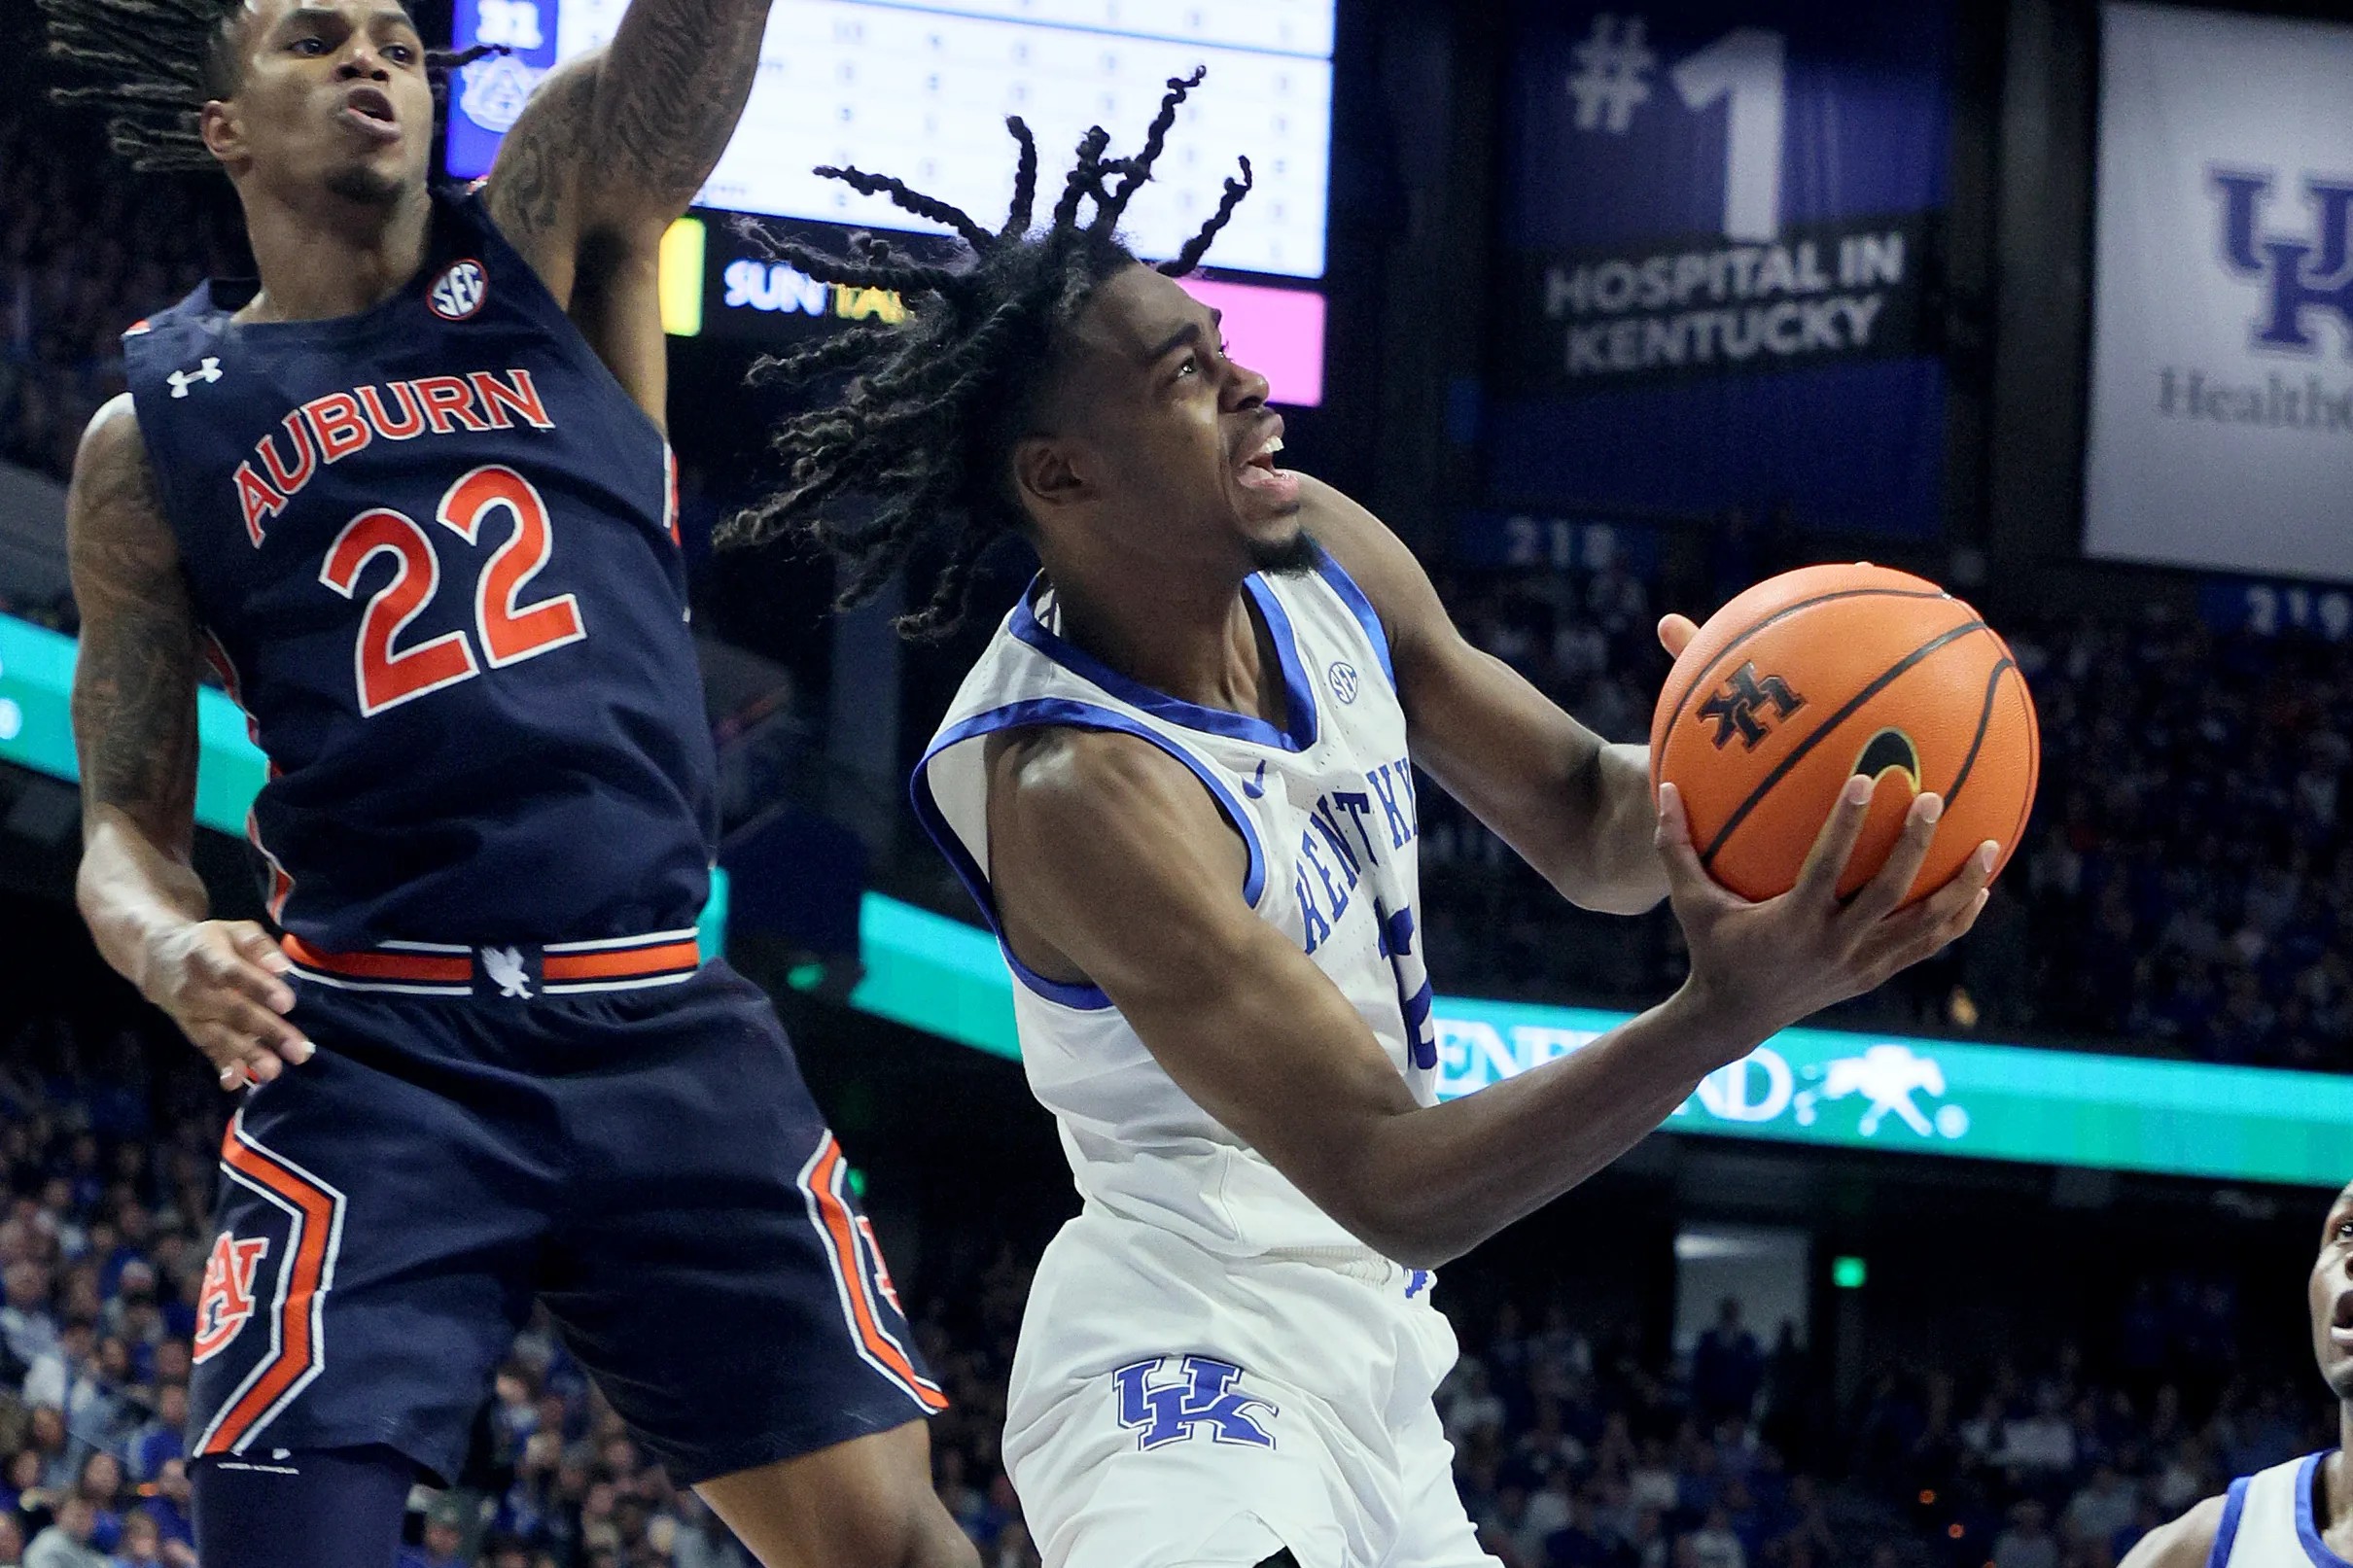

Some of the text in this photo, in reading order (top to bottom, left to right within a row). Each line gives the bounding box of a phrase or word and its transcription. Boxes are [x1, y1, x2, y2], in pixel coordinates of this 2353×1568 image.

[1566, 14, 1787, 241] #1
[431, 261, 485, 318] SEC
[723, 259, 826, 318] SUN
[1546, 232, 1904, 318] HOSPITAL IN
[1566, 293, 1881, 374] KENTUCKY
[232, 368, 556, 550] AUBURN
[318, 464, 587, 718] 22
[1329, 662, 1358, 705] SEC
[1111, 1353, 1280, 1451] UK
